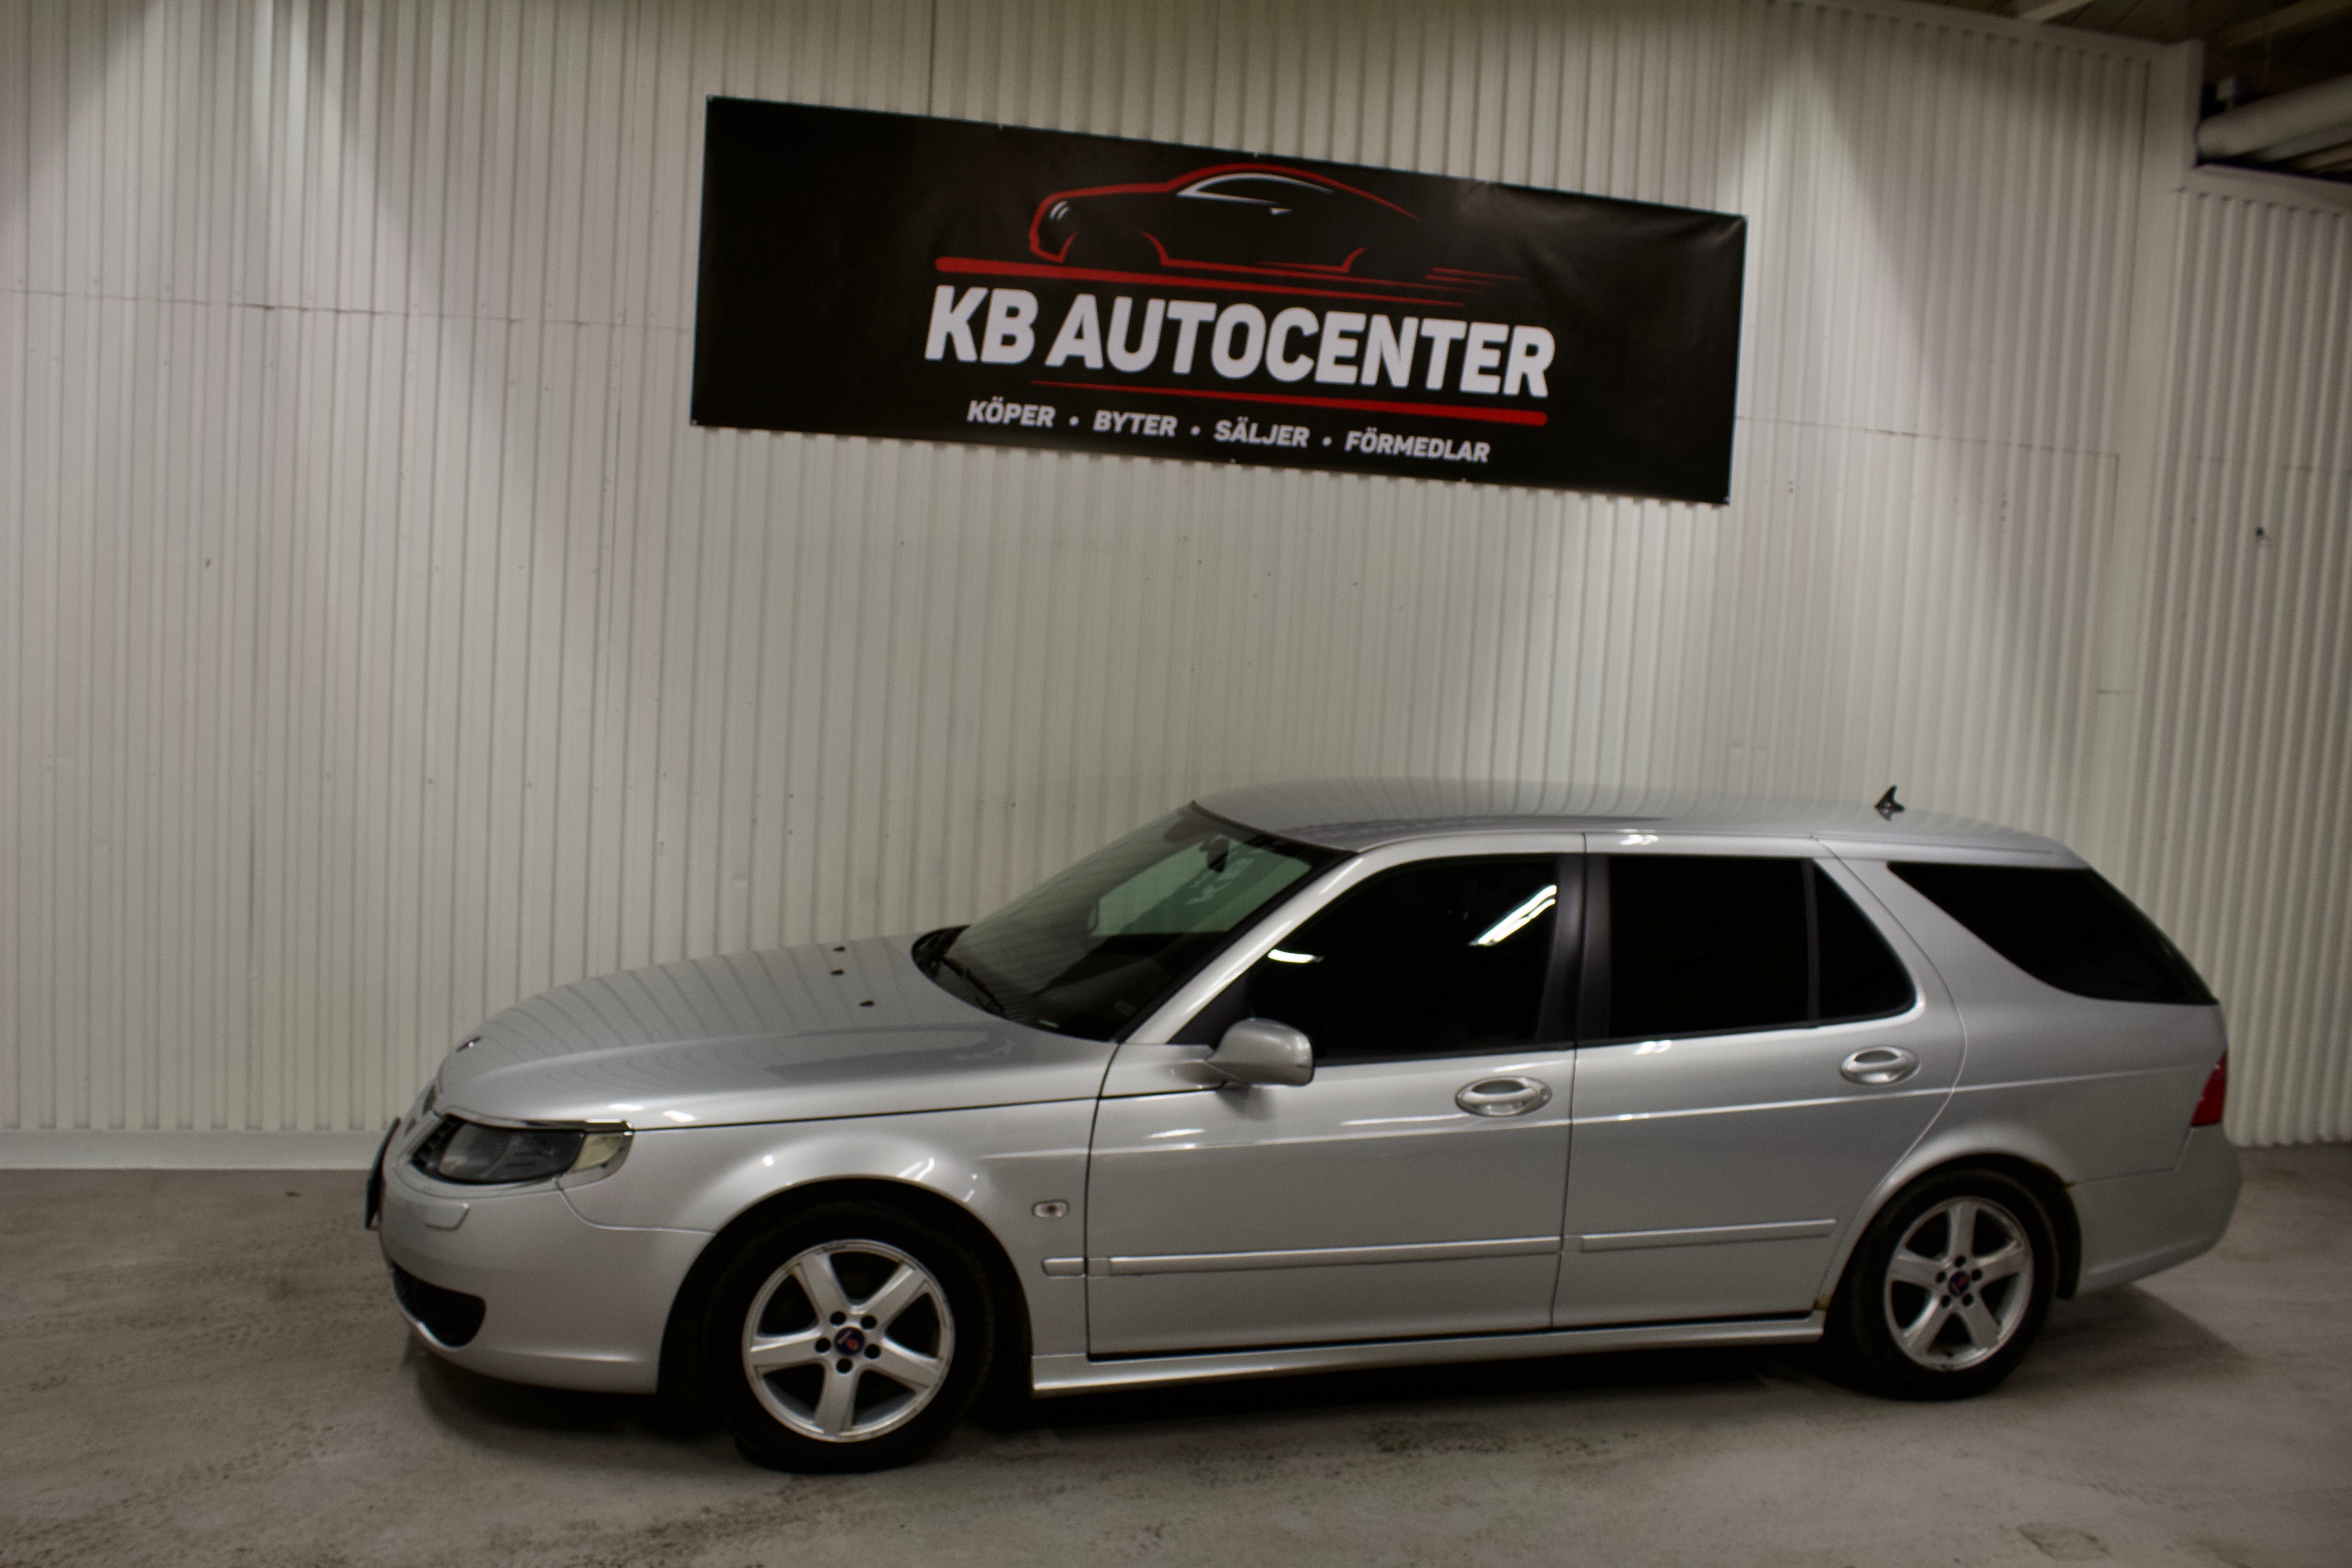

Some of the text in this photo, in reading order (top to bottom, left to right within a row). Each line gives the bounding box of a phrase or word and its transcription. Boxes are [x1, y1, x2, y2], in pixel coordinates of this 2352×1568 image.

[925, 285, 1555, 397] KB AUTOCENTER
[967, 396, 1490, 463] KÖPER BYTER SÄLJER FÖRMEDLAR
